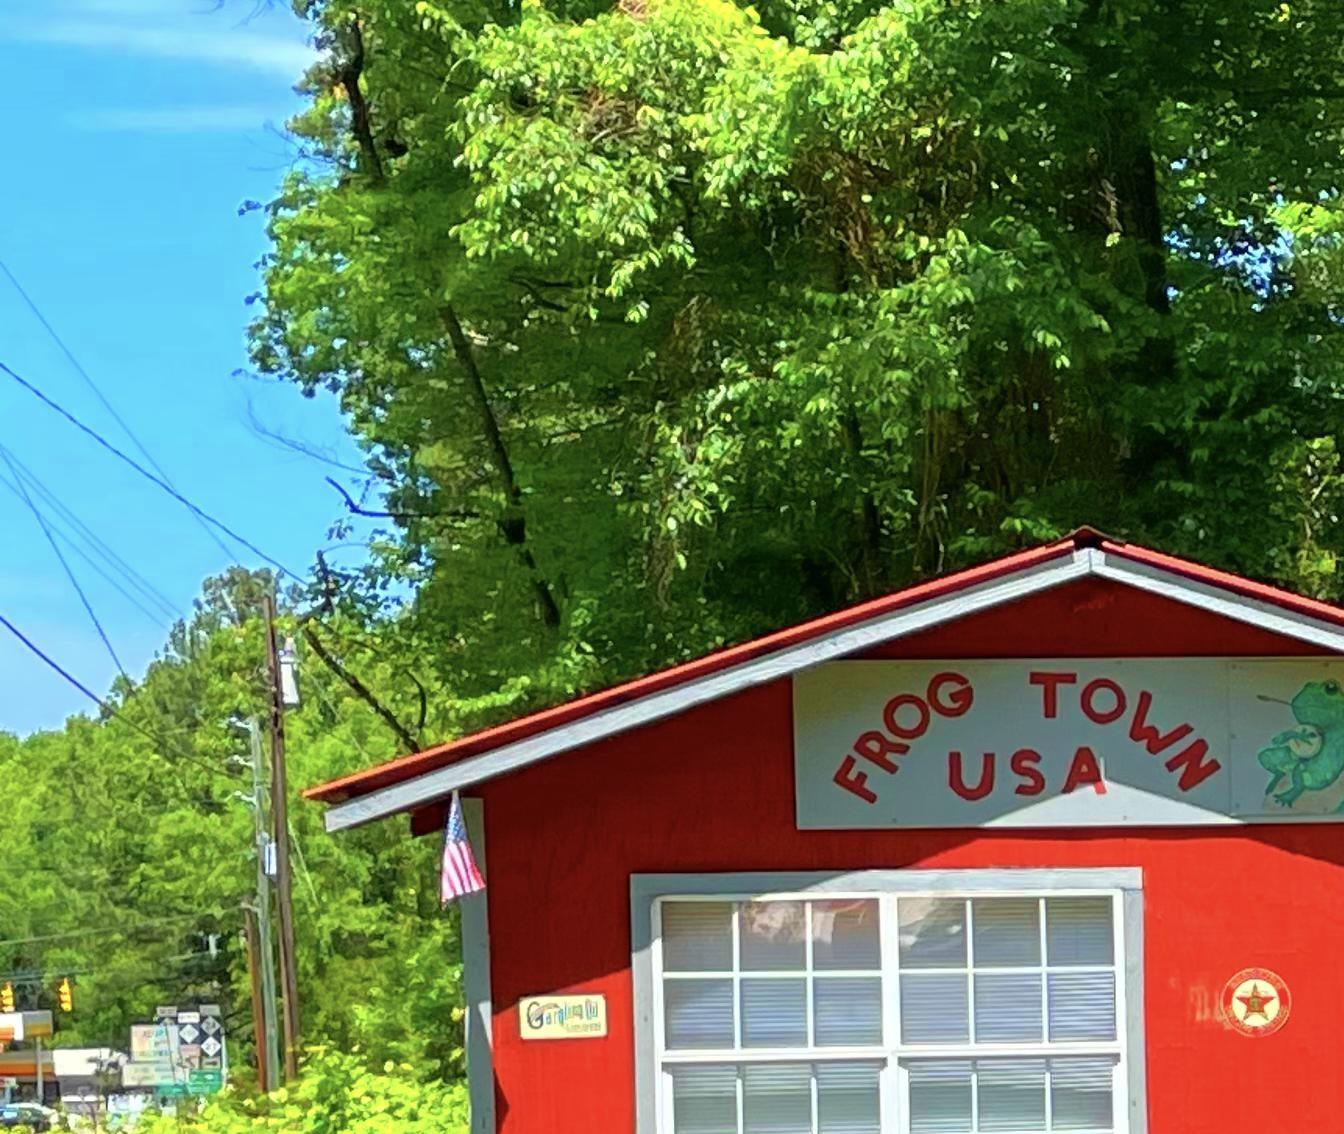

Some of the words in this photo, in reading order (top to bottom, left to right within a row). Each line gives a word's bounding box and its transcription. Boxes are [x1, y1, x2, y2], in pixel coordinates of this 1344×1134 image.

[834, 671, 975, 804] FROG
[1030, 671, 1222, 792] TOWN
[948, 746, 1107, 799] USA
